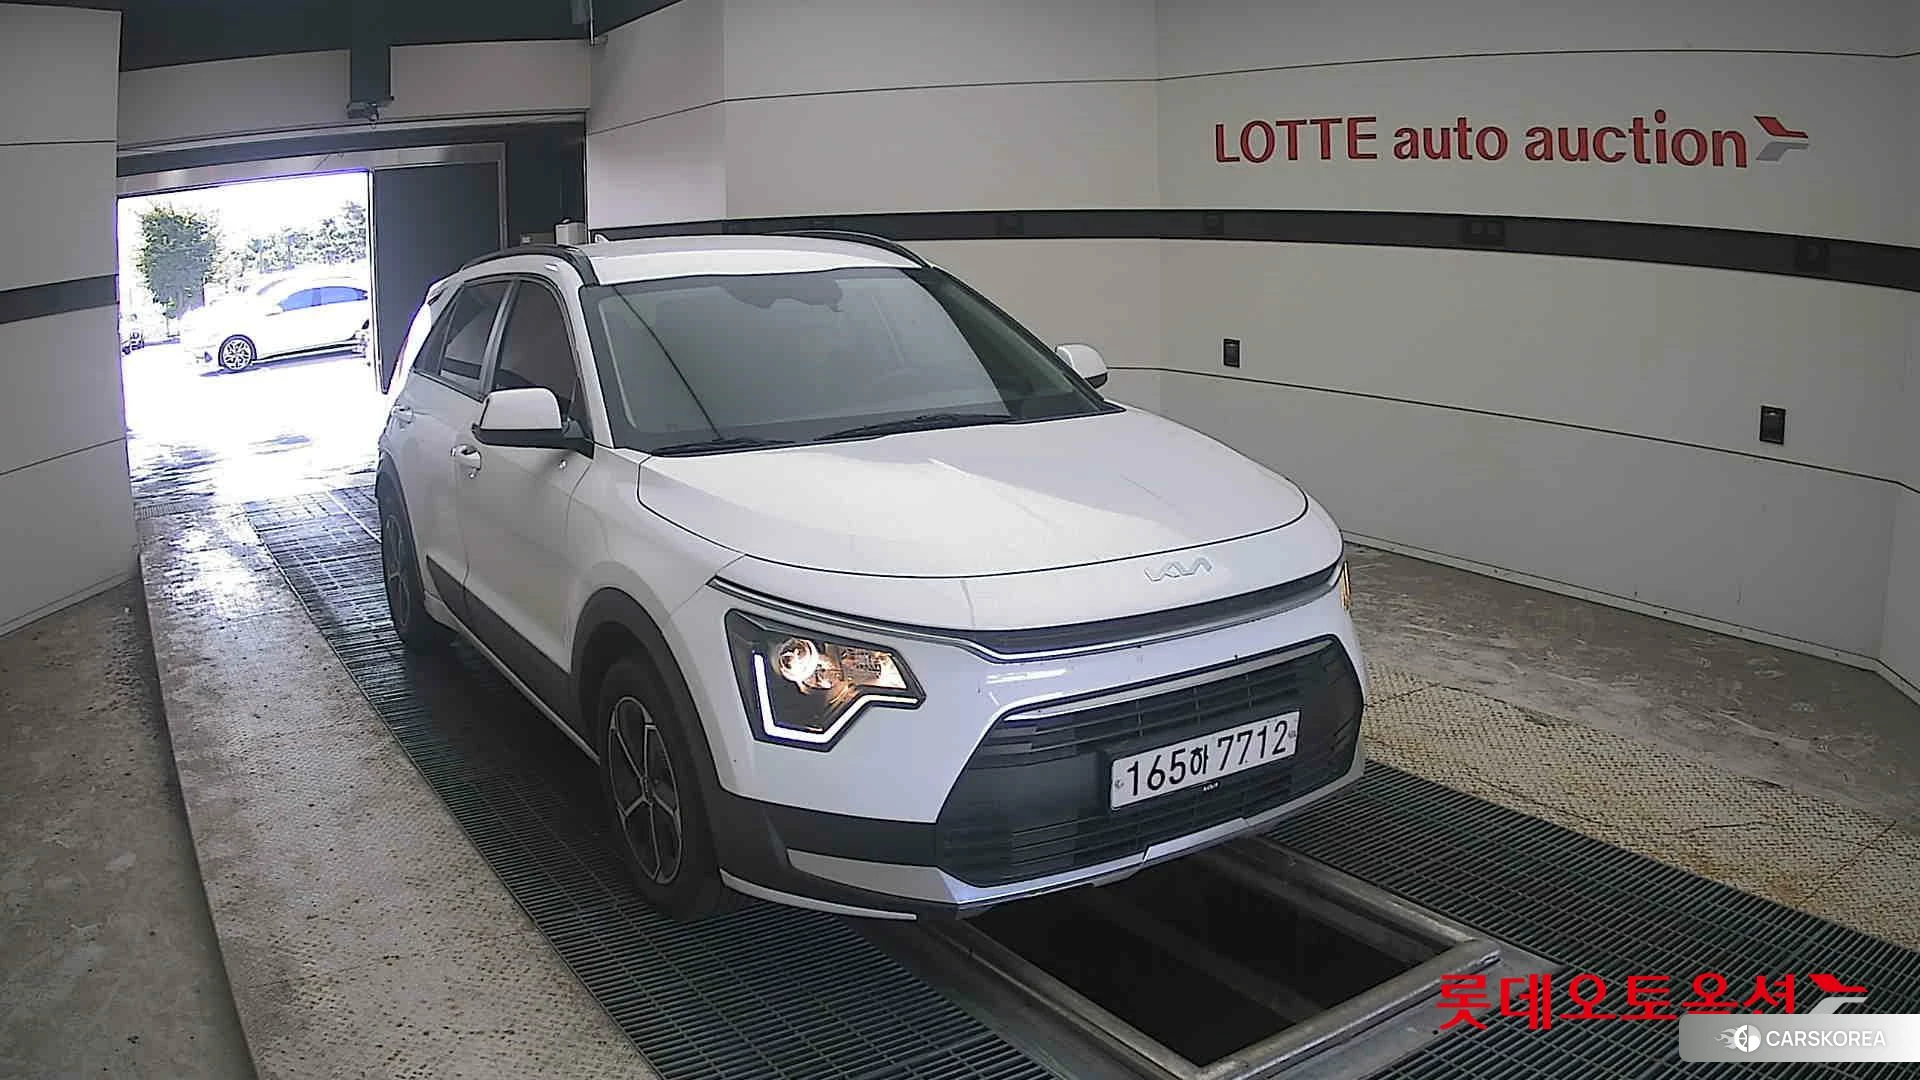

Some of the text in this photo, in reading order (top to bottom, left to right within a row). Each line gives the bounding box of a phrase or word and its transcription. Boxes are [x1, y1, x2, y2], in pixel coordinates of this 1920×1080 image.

[1214, 108, 1748, 169] LOTTE auto auction
[1217, 719, 1289, 772] 7712
